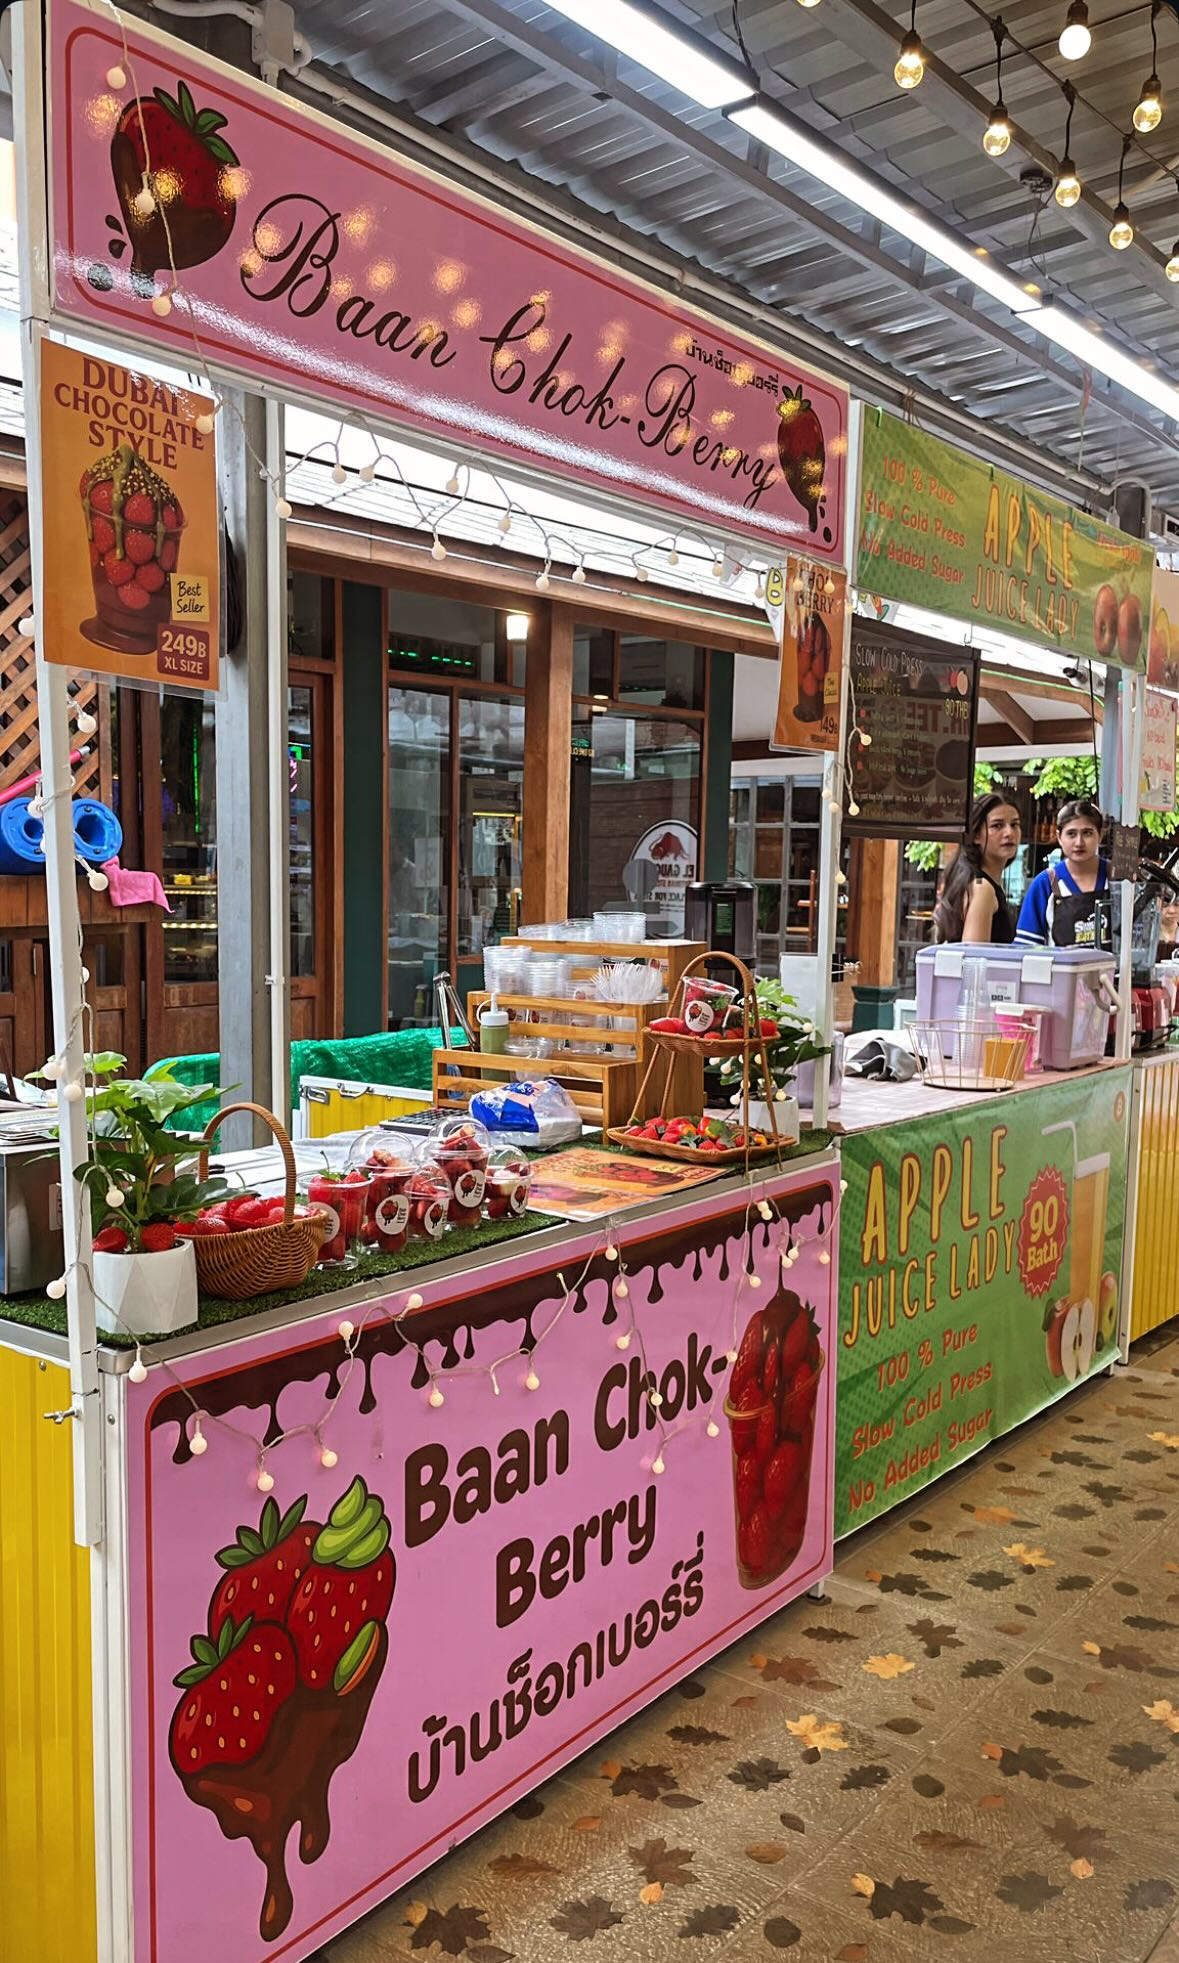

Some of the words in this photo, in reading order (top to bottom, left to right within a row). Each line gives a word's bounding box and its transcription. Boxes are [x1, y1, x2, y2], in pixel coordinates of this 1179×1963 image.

[240, 193, 457, 368] Baan
[480, 297, 778, 510] Chok-Berry
[54, 383, 205, 450] CHOCOLATE
[83, 356, 179, 417] DUBAI
[88, 420, 178, 470] STYLE
[883, 456, 906, 486] 100
[911, 468, 924, 493] %
[928, 477, 956, 506] Pure
[865, 489, 895, 520] Slow
[901, 505, 929, 533] Cold
[935, 518, 965, 548] Press
[984, 484, 1073, 591] APPLE
[176, 580, 202, 598] Best
[887, 537, 926, 571] Added
[931, 554, 964, 583] Sugar
[176, 598, 206, 614] Seller
[972, 564, 1030, 625] JUICE
[1034, 585, 1079, 641] LADY
[164, 656, 178, 670] XL
[180, 659, 204, 674] SIZE
[862, 1124, 1008, 1268] APPLE
[1029, 1194, 1060, 1243] 90
[843, 1251, 937, 1348] JUICE
[950, 1218, 1016, 1301] LADY
[1026, 1238, 1059, 1273] Bath
[877, 1351, 909, 1392] 100
[917, 1339, 934, 1370] %
[943, 1323, 978, 1357] Pure
[404, 1409, 570, 1549] Baan
[594, 1332, 728, 1452] Chok-
[852, 1417, 896, 1460] Slow
[903, 1382, 943, 1428] Cold
[950, 1361, 993, 1400] Press
[848, 1479, 876, 1514] No
[884, 1432, 942, 1491] Added
[946, 1407, 993, 1451] Sugar
[496, 1484, 657, 1629] Berry
[407, 1530, 704, 1804] บ้านช็อกเบอร์รี่
